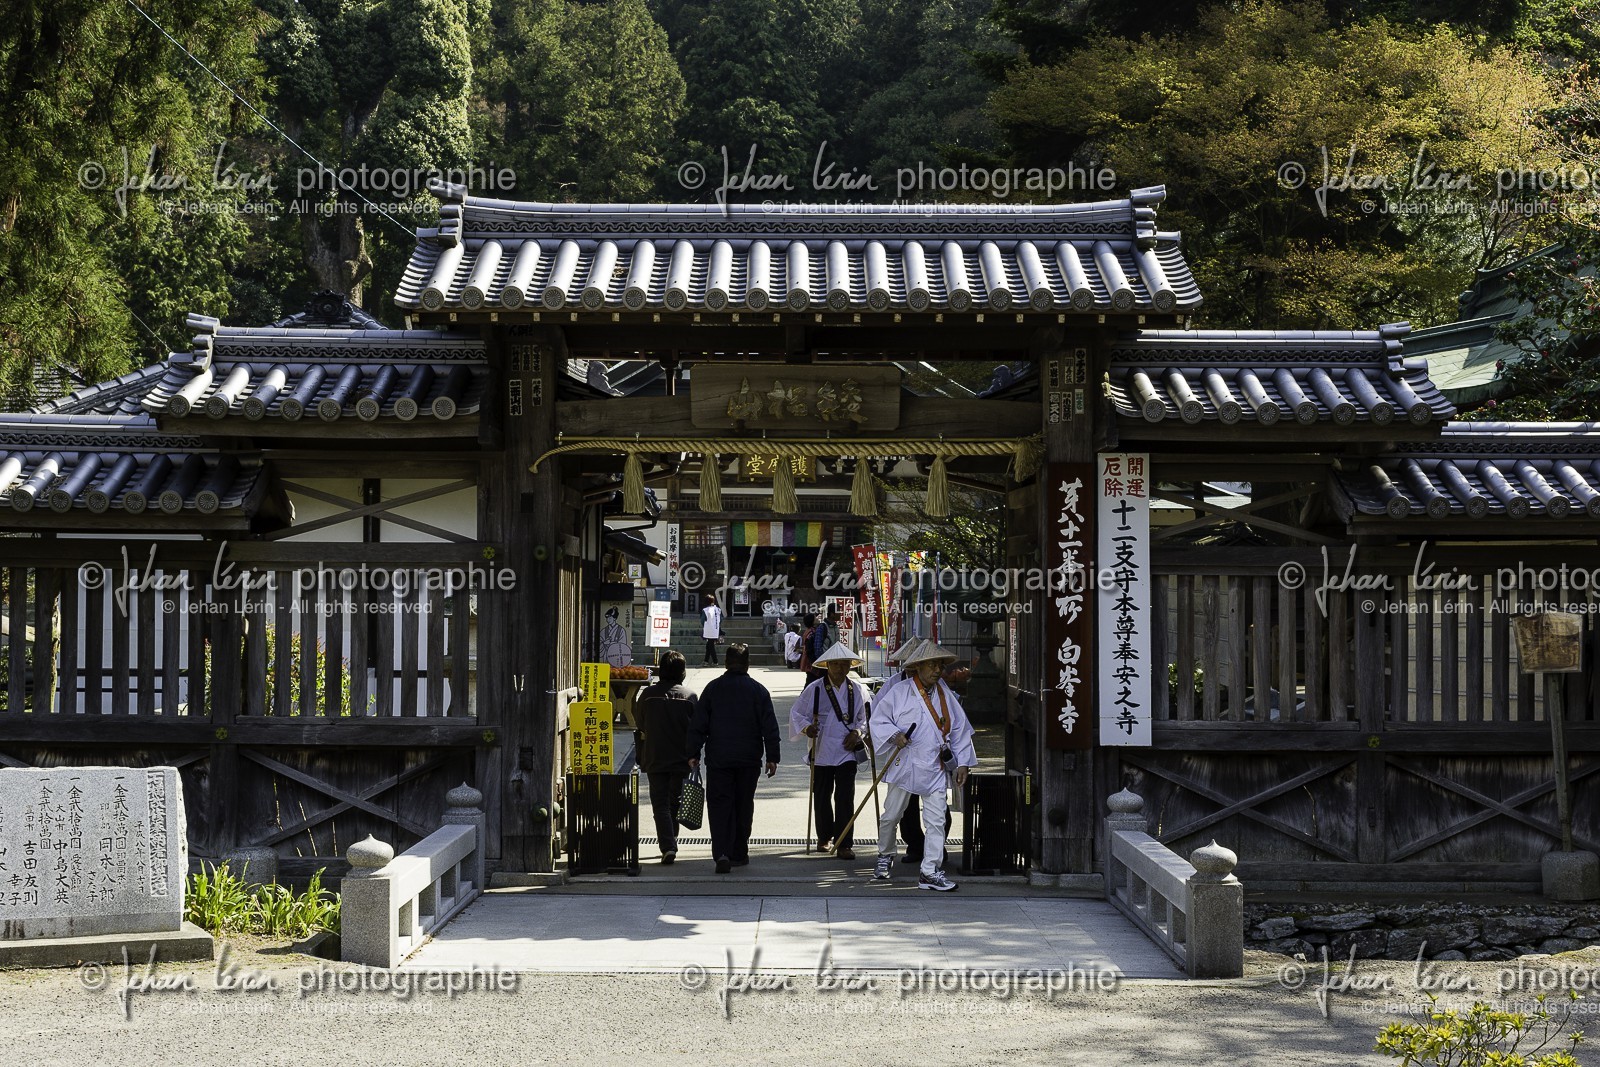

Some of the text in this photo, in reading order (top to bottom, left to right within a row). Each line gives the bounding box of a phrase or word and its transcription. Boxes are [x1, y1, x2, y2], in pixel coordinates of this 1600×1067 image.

[1103, 457, 1124, 498] 厄除
[1125, 457, 1147, 498] 開運
[1110, 500, 1140, 735] 十二支守本尊奉安之寺
[584, 707, 598, 774] 午前七時〜午後
[7, 874, 23, 906] 幸子
[53, 839, 70, 905] 中島大英
[99, 837, 116, 902] 岡本八郎
